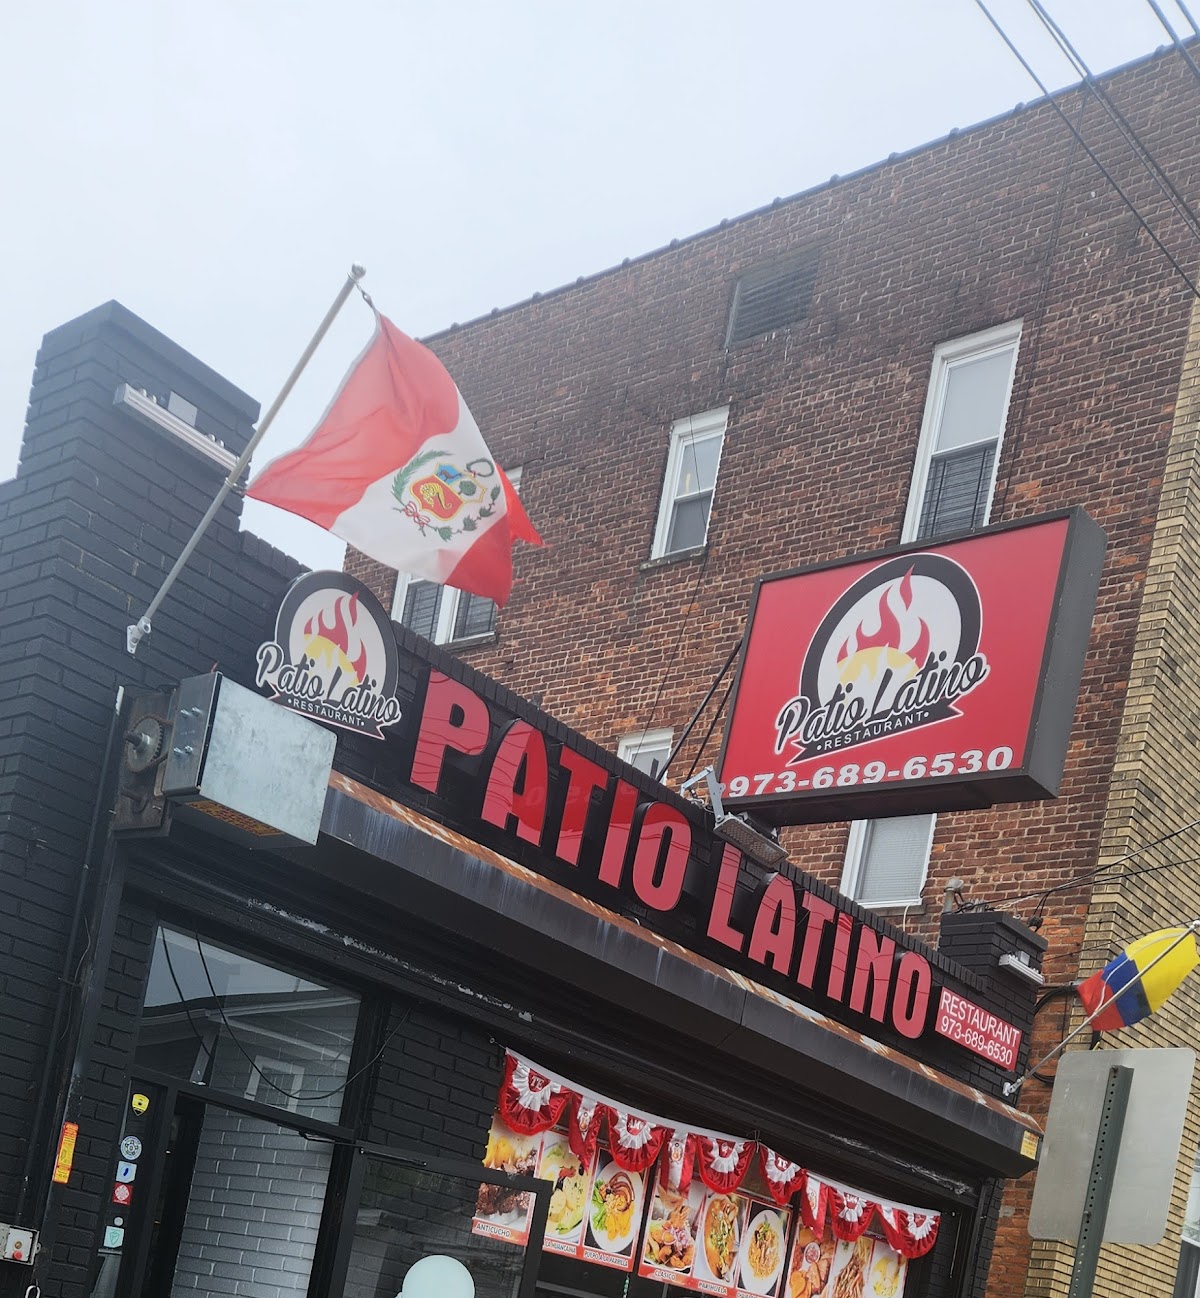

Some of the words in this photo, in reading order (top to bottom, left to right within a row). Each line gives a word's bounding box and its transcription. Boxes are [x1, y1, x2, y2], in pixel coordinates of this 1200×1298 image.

[258, 643, 325, 698] Patio
[322, 665, 401, 723] Latino
[777, 682, 867, 751] Patio
[864, 650, 987, 723] Latino
[294, 698, 361, 727] RESTAURANT
[824, 710, 924, 751] RESTAURANT
[728, 746, 1014, 798] 973-689-6530
[409, 667, 693, 912] PATIO
[706, 841, 933, 1040] LATINO
[941, 991, 1020, 1048] RESTAURANT
[941, 1015, 1013, 1065] 973-689-6530
[476, 1222, 511, 1238] ANTICUCHO
[698, 1281, 728, 1295] PARIHUELA
